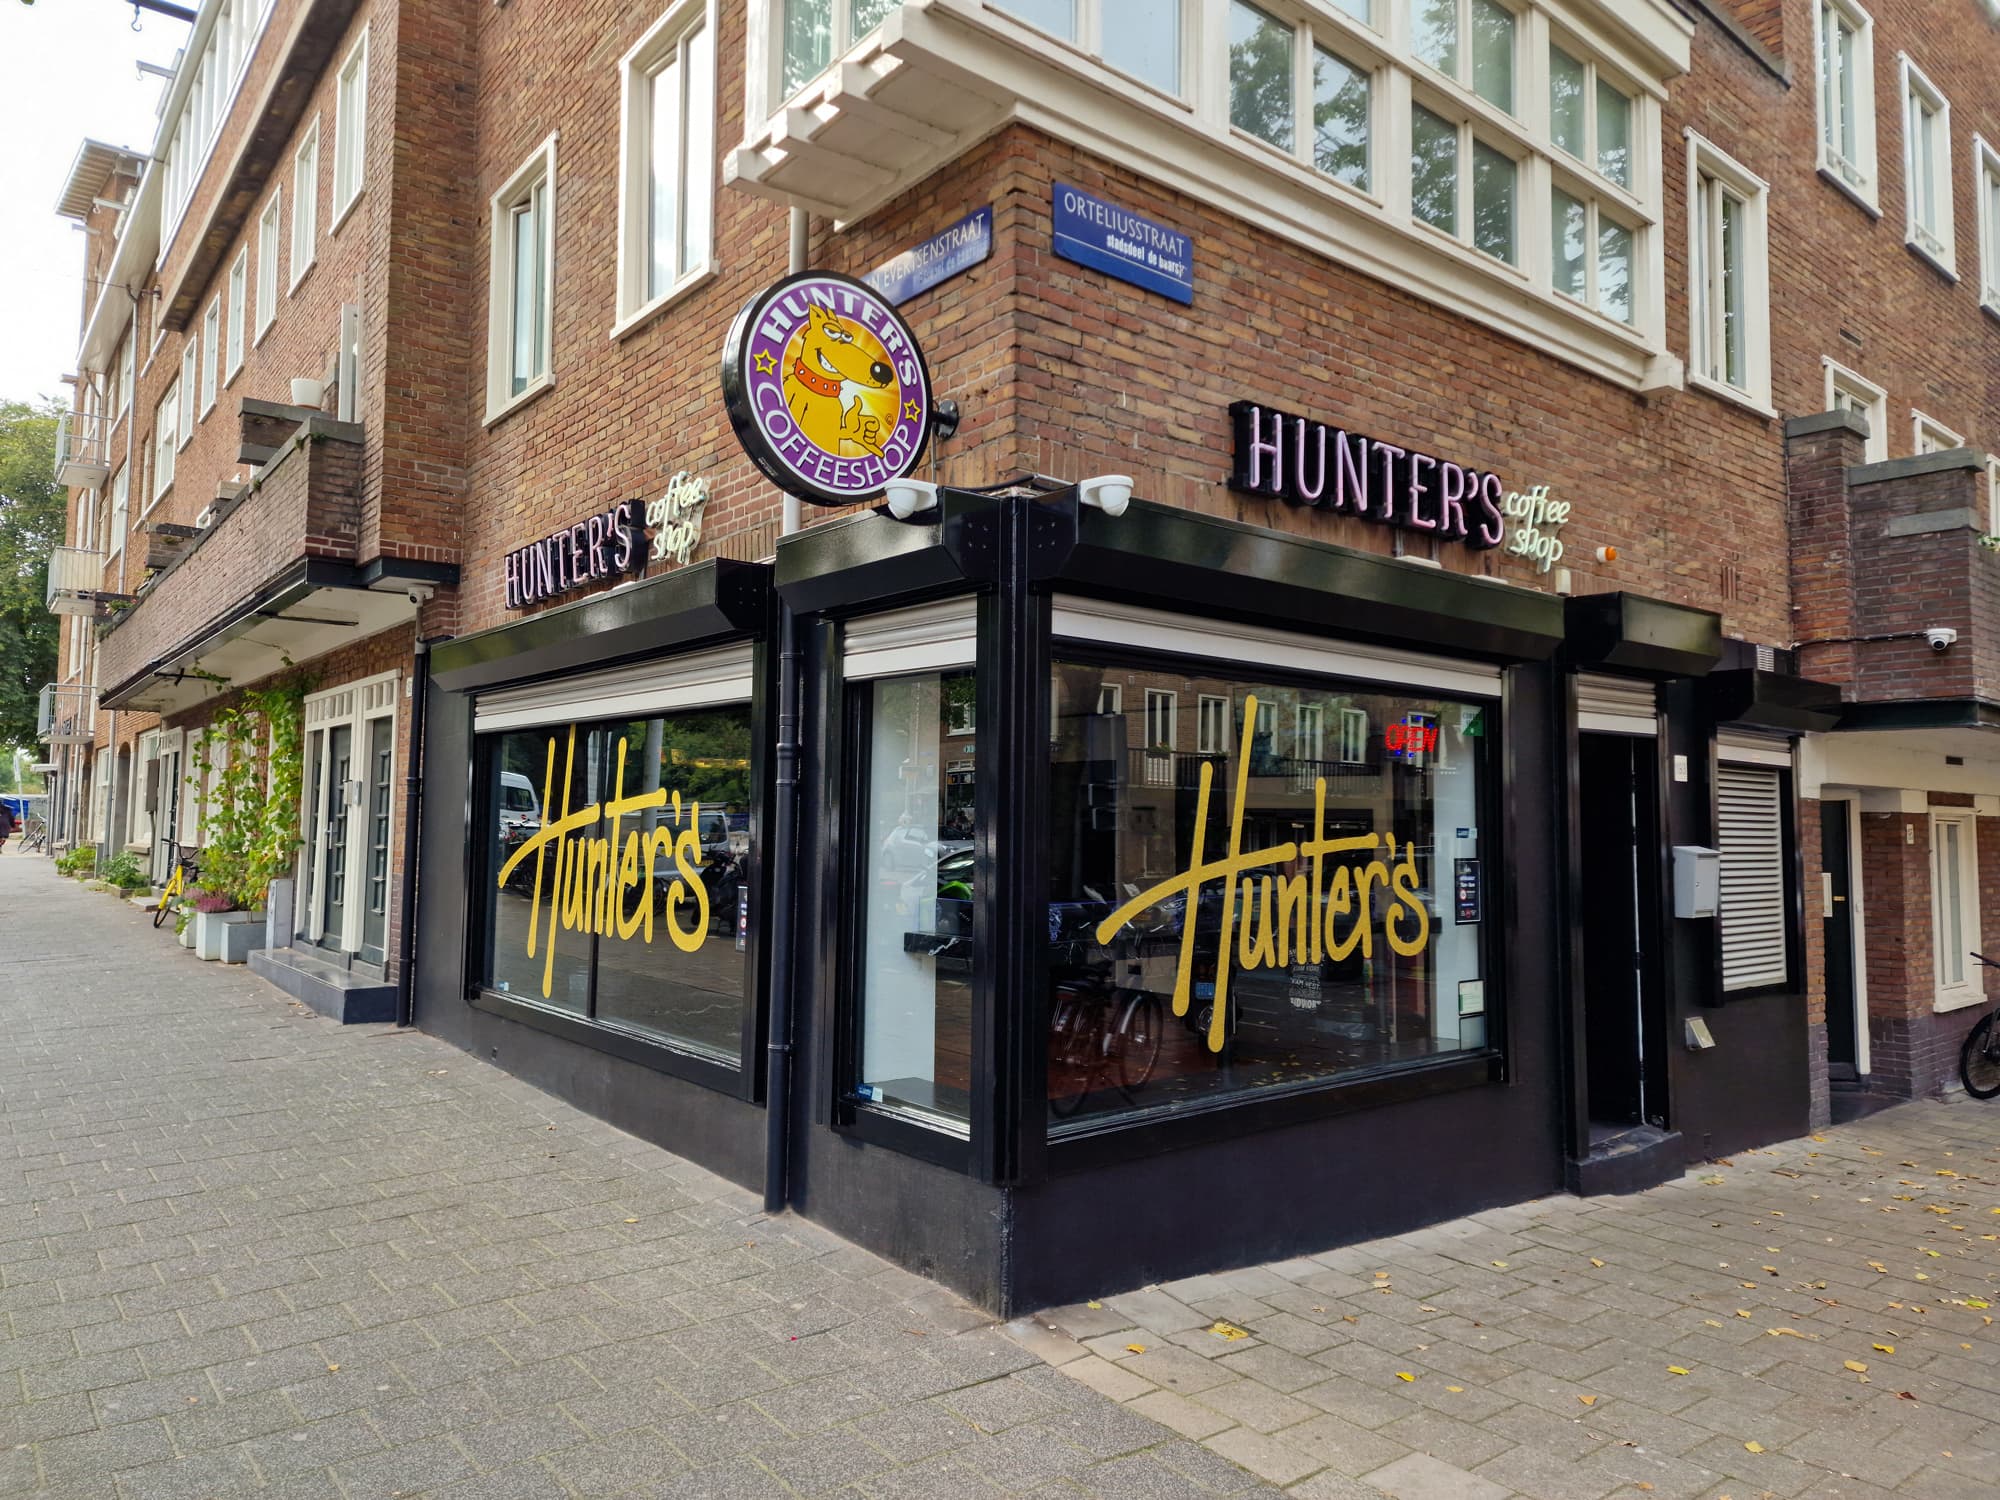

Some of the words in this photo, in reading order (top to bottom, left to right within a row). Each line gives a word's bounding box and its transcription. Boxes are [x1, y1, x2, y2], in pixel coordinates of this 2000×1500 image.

[883, 213, 985, 288] EVERTSENSTRAAT
[1064, 191, 1184, 257] ORTELIUSSTRAAT
[1106, 234, 1145, 260] stadsdeel
[1147, 249, 1157, 266] de
[759, 286, 918, 387] HUNTER'S
[756, 382, 912, 489] COFFEESHOP
[646, 470, 706, 527] coffee
[1250, 406, 1504, 546] HUNTER'S
[1505, 485, 1572, 530] coffee
[504, 503, 632, 609] HUNTER'S
[651, 521, 695, 565] shop
[1510, 527, 1564, 574] shop
[1384, 723, 1439, 753] OPEN
[497, 722, 710, 999] Hunter's
[1095, 694, 1430, 1053] Hunter's
